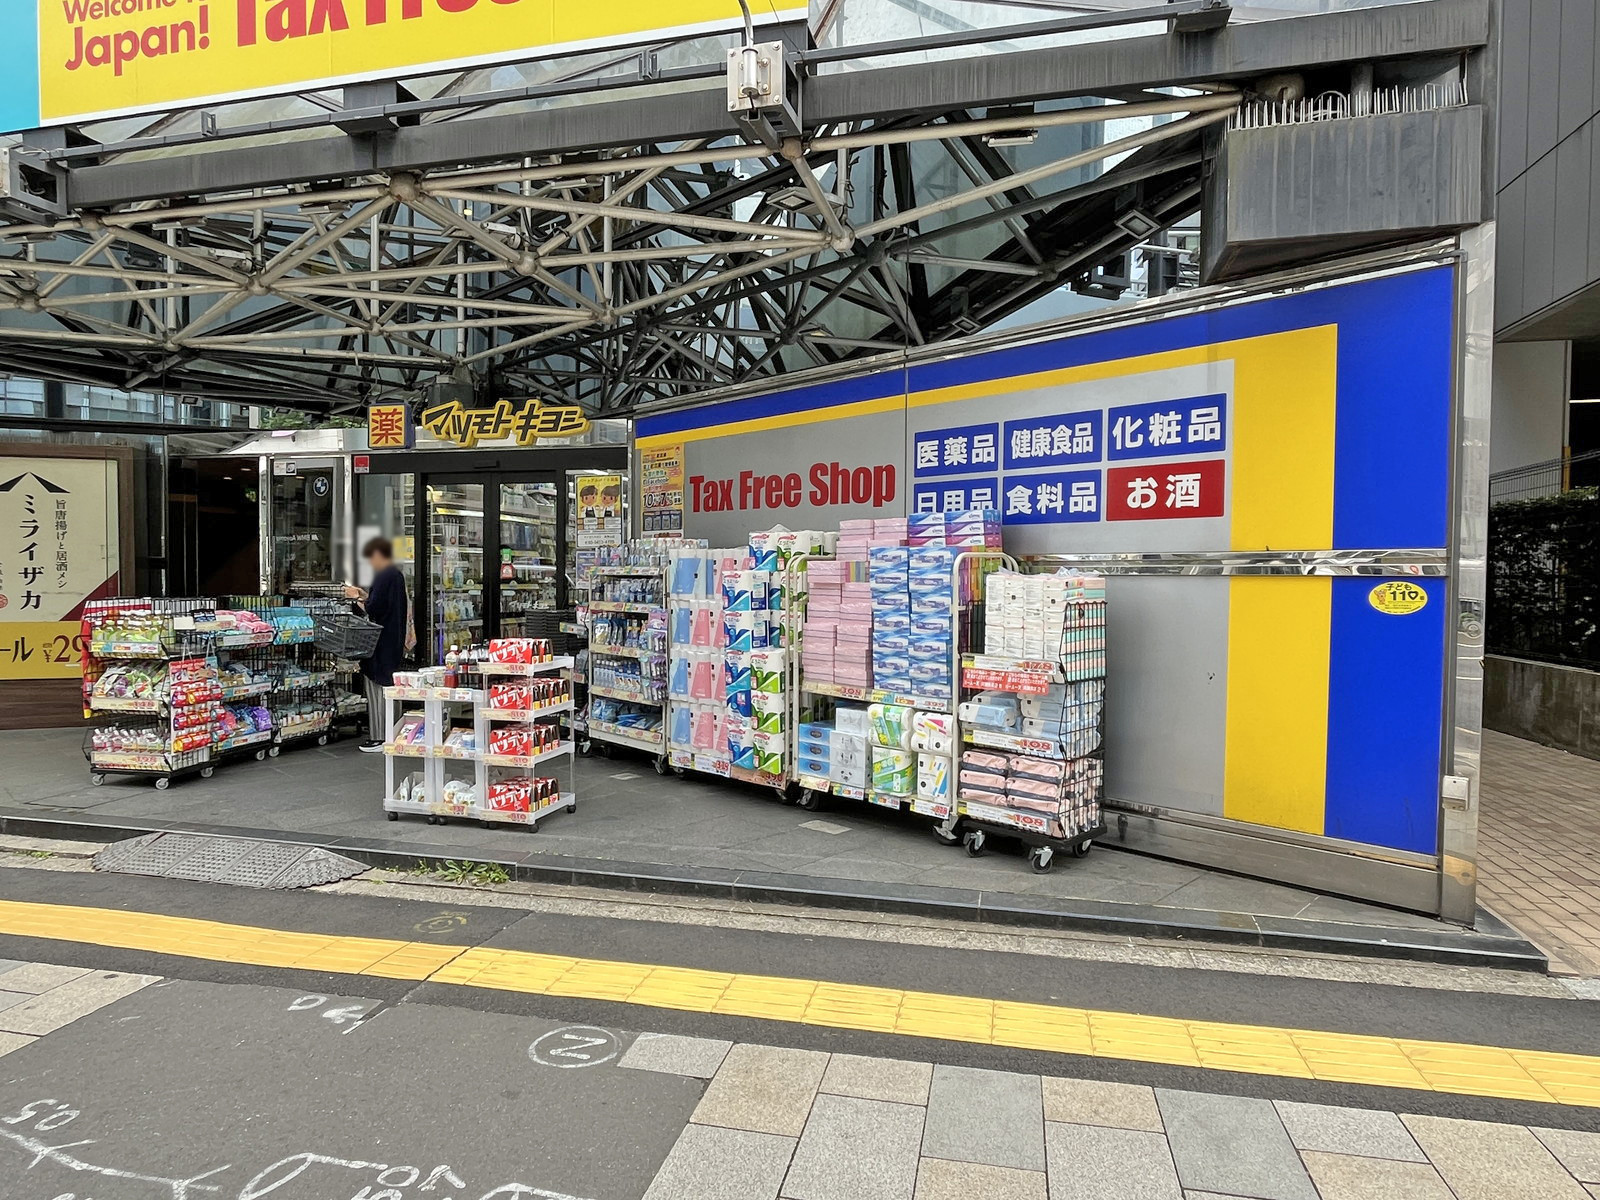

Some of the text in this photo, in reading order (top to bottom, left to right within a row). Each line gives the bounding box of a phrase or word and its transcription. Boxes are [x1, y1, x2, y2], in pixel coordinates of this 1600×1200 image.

[65, 5, 210, 76] Japan!
[371, 409, 403, 445] 薬
[423, 400, 586, 443] マツモトキヨシ
[1112, 406, 1222, 450] 化粧品
[916, 430, 996, 469] 医薬品
[1010, 422, 1094, 460] 健康食品
[689, 461, 897, 513] Tax Free Shop
[916, 487, 994, 513] 日用品
[1006, 481, 1097, 516] 食料品
[1126, 473, 1202, 510] お酒
[18, 494, 45, 611] ミライザカ
[55, 498, 68, 589] 旨唐揚げと居酒メシ
[1386, 583, 1412, 591] 子ども
[1021, 739, 1052, 750] 108
[1014, 814, 1044, 827] 108
